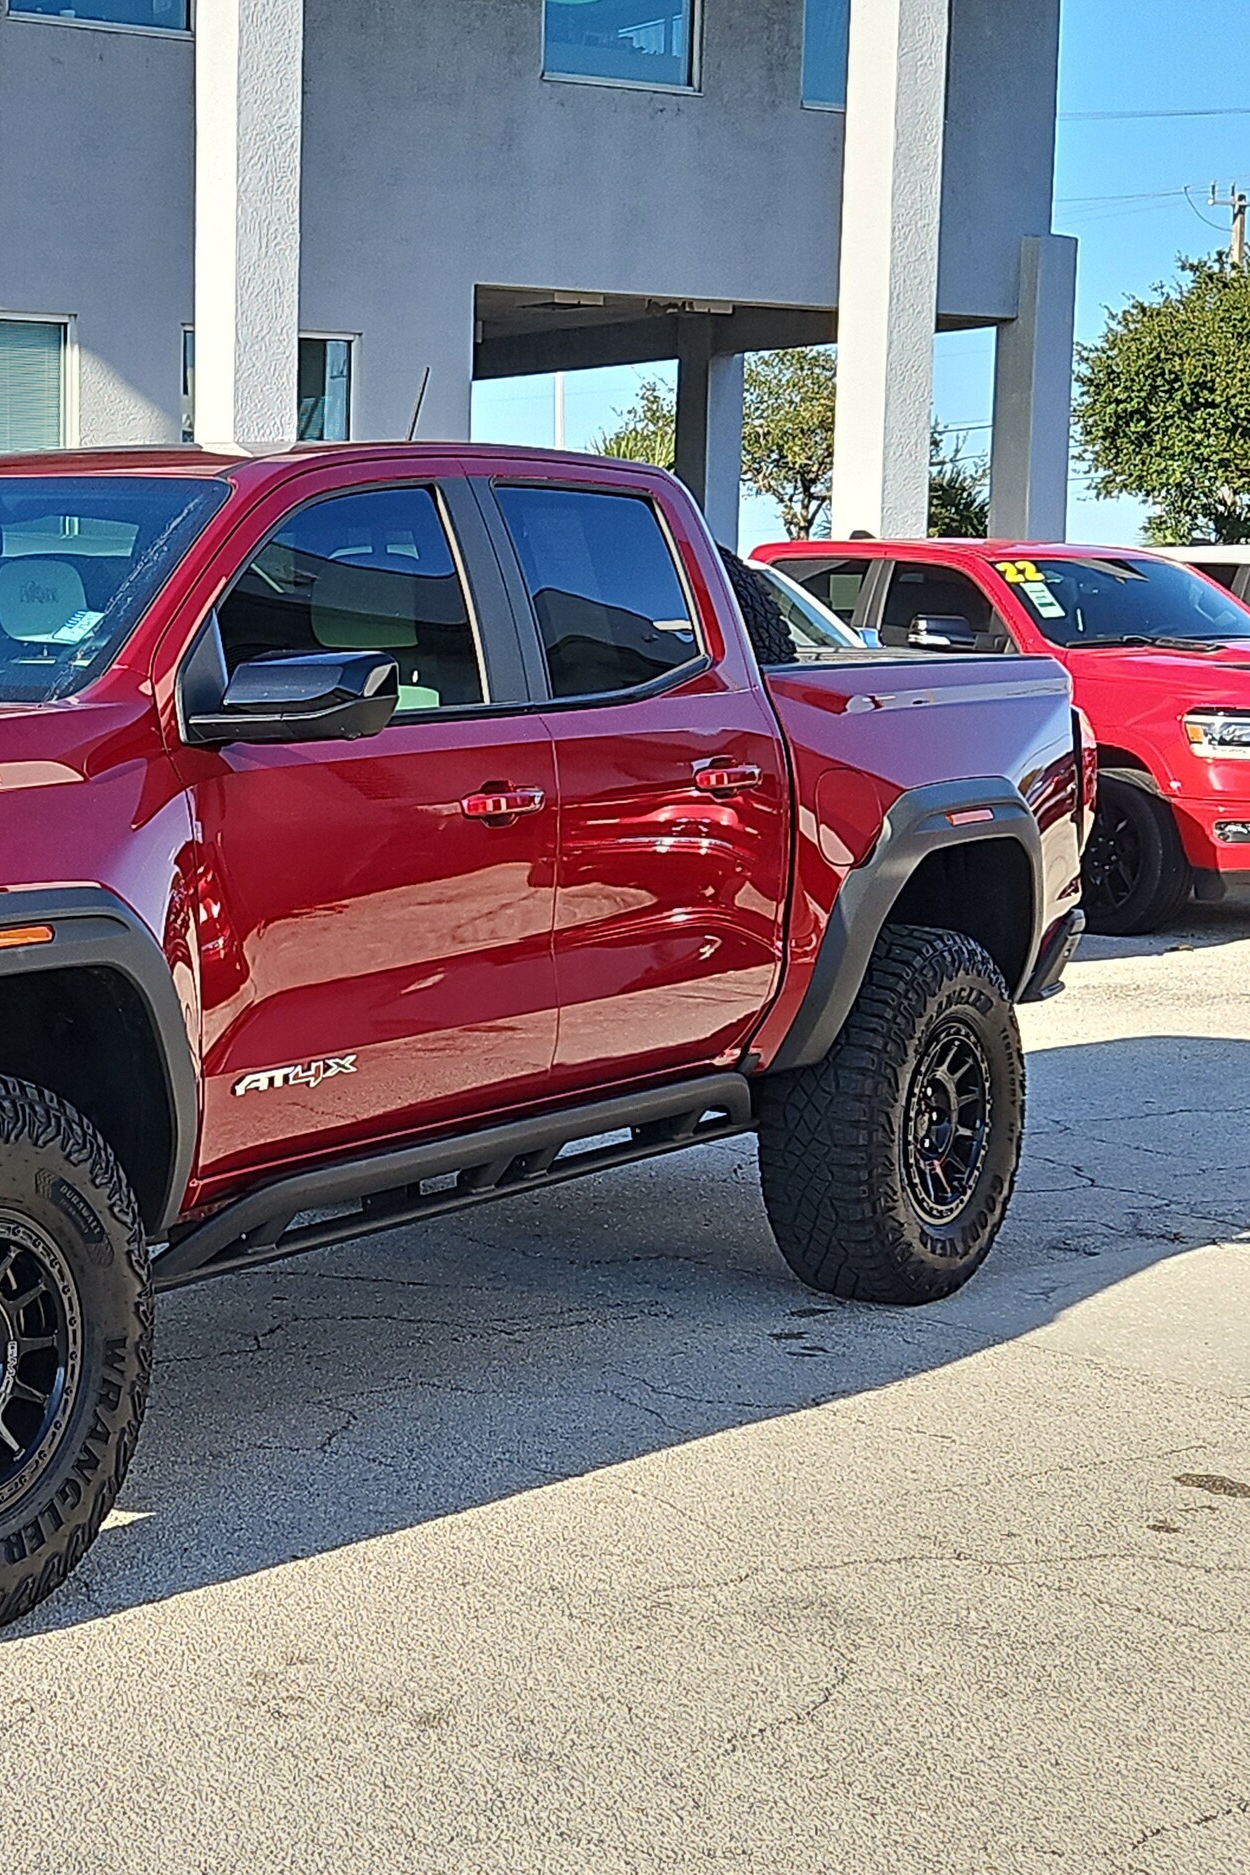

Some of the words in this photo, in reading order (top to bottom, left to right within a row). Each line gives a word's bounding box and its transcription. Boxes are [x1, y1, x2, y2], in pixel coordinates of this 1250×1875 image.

[994, 561, 1045, 583] 22
[234, 1054, 358, 1097] AT4X
[0, 1335, 128, 1565] WRANGLER
